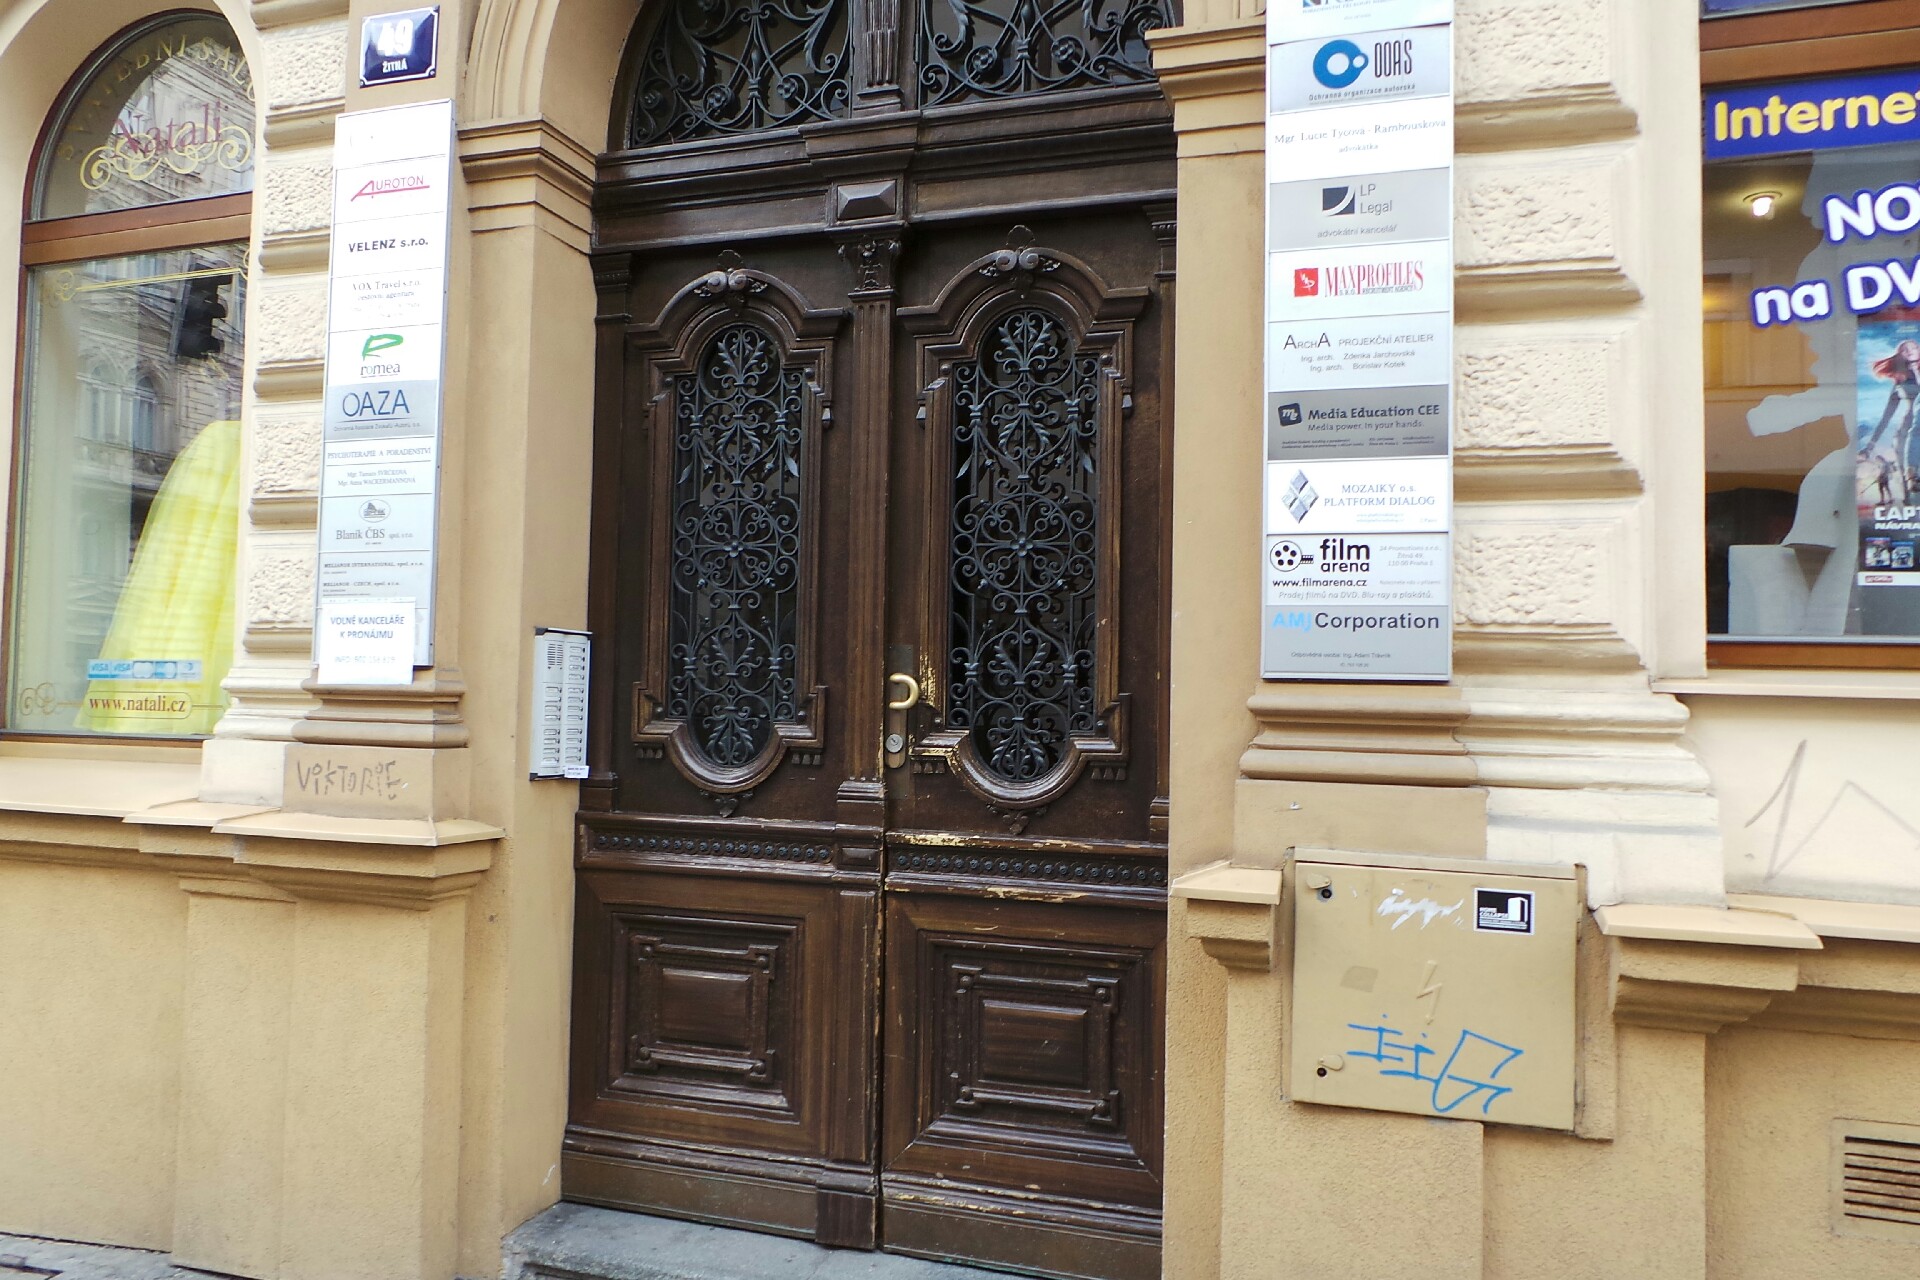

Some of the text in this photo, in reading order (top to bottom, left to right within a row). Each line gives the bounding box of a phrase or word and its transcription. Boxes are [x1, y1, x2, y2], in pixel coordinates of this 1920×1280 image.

[382, 57, 408, 74] ŽITNÁ
[1343, 87, 1382, 99] organizace
[1384, 83, 1416, 92] autorská
[1714, 91, 1920, 142] Interne
[112, 100, 223, 158] Natali
[1300, 131, 1328, 141] Lucie
[351, 175, 425, 201] AUROTON
[1360, 183, 1377, 197] LP
[1360, 200, 1393, 216] Legal
[1825, 185, 1920, 242] NO
[349, 238, 428, 253] VELENZ s.r.o.
[1325, 260, 1424, 298] MAXPROFILES
[1754, 281, 1830, 325] na
[1339, 334, 1392, 347] PROJEKČNÍ
[1393, 333, 1434, 344] ATELIER
[1301, 355, 1315, 363] Ing.
[360, 363, 400, 375] romea
[1310, 364, 1324, 373] Ing.
[342, 390, 410, 417] OAZA
[1308, 408, 1347, 420] Media
[1350, 405, 1414, 418] Education
[1417, 405, 1440, 416] CEE
[1308, 423, 1334, 431] Media
[1374, 421, 1394, 430] your
[1341, 484, 1417, 494] MOZAIKY o.s.
[1324, 496, 1436, 507] PLATFORM DIALOG
[365, 527, 386, 539] ČBS
[1320, 538, 1370, 561] film
[1320, 561, 1370, 572] arena
[1272, 578, 1367, 587] www.filmarena.cz
[1279, 591, 1305, 600] Prodej
[1306, 590, 1327, 600] filmů
[1362, 591, 1391, 600] Blu-ray
[330, 614, 405, 625] VOLNÉ KANCELÁŘE
[1272, 611, 1439, 632] AMJ Corporation
[340, 628, 394, 639] K PRONÁJMU
[89, 695, 186, 712] www.natali.cz
